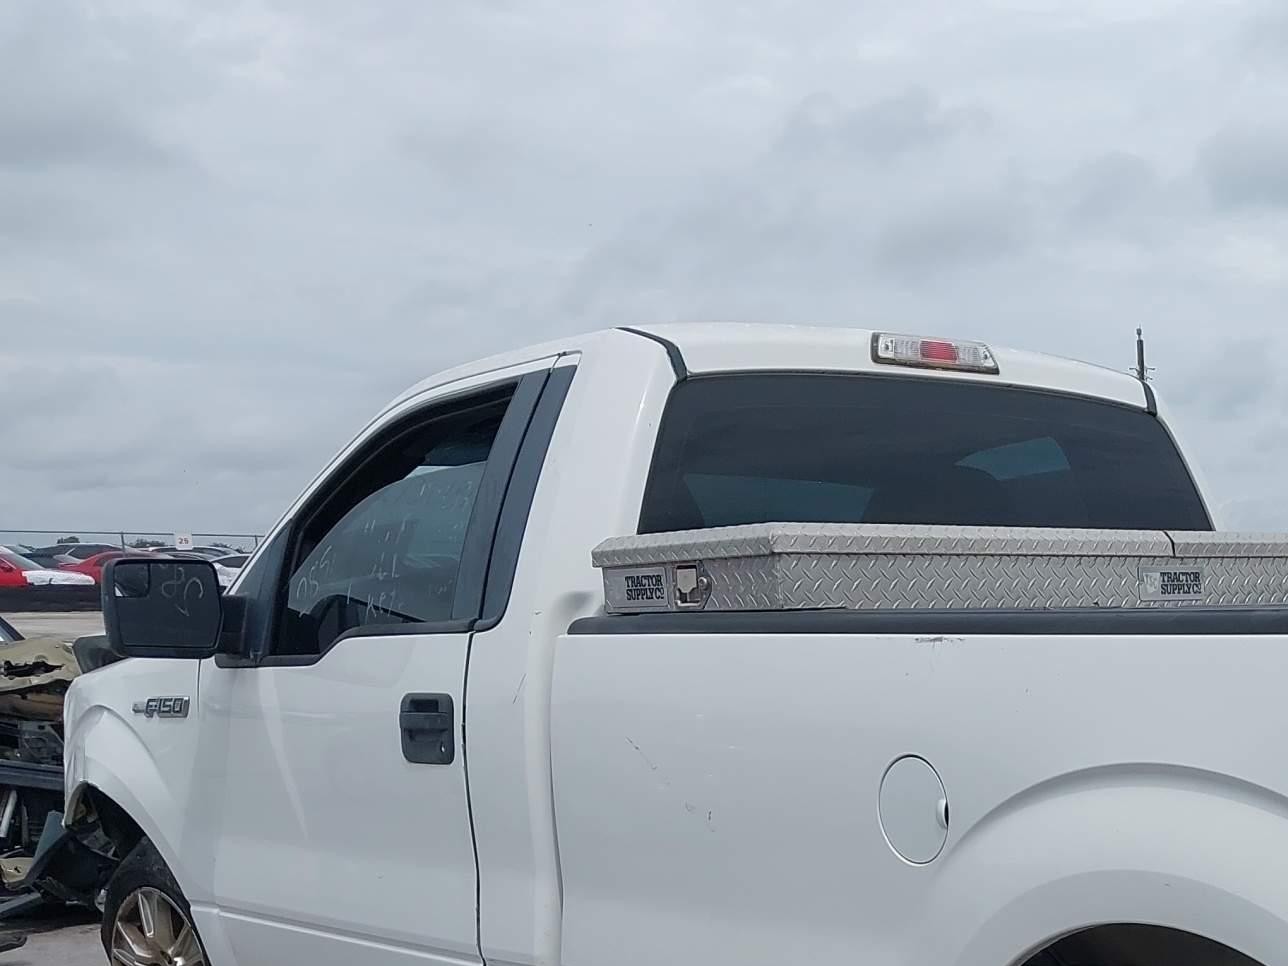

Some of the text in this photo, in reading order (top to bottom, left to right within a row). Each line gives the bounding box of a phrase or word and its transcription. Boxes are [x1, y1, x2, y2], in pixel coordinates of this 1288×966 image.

[625, 574, 663, 587] TRACTOR
[1160, 571, 1201, 583] TRACTOR
[626, 587, 654, 600] SUPPLY
[1160, 584, 1192, 595] SUPPLY
